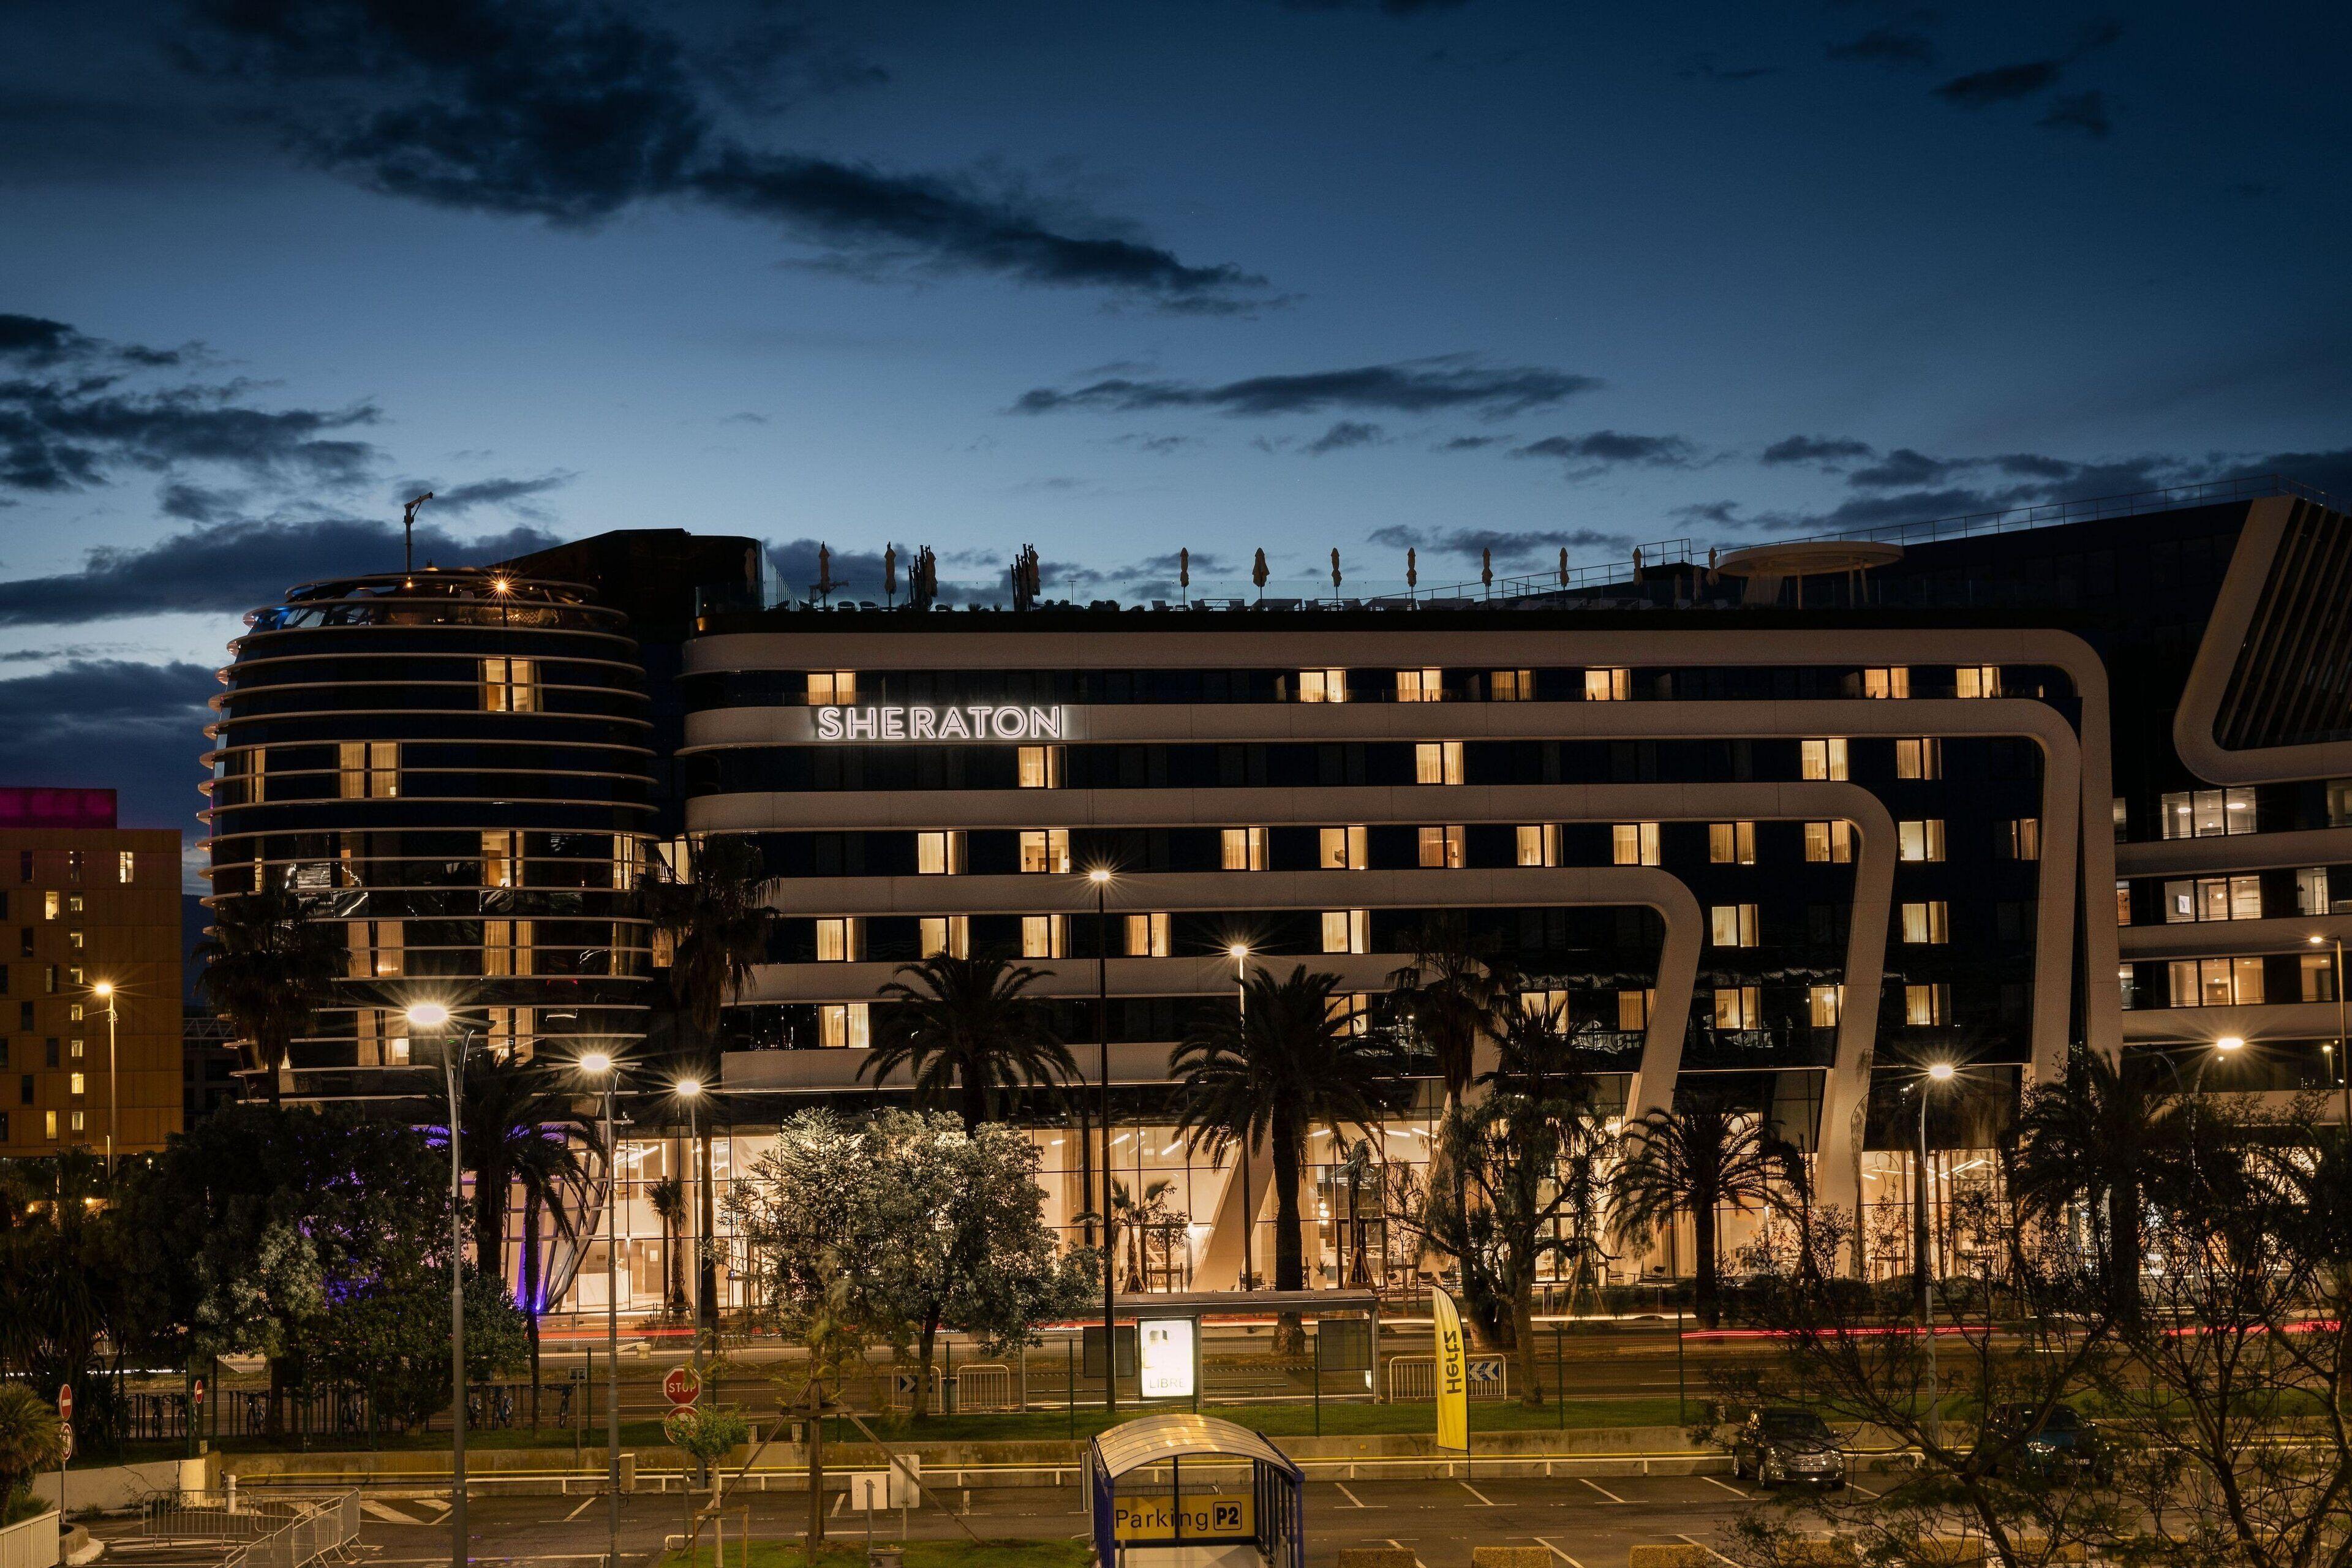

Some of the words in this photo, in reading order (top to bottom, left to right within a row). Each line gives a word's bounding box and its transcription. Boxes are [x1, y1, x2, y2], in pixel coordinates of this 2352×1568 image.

[819, 707, 1060, 739] SHERATON
[1150, 1378, 1186, 1389] LIBRE
[1115, 1509, 1208, 1531] Parking
[1216, 1506, 1239, 1525] P2
